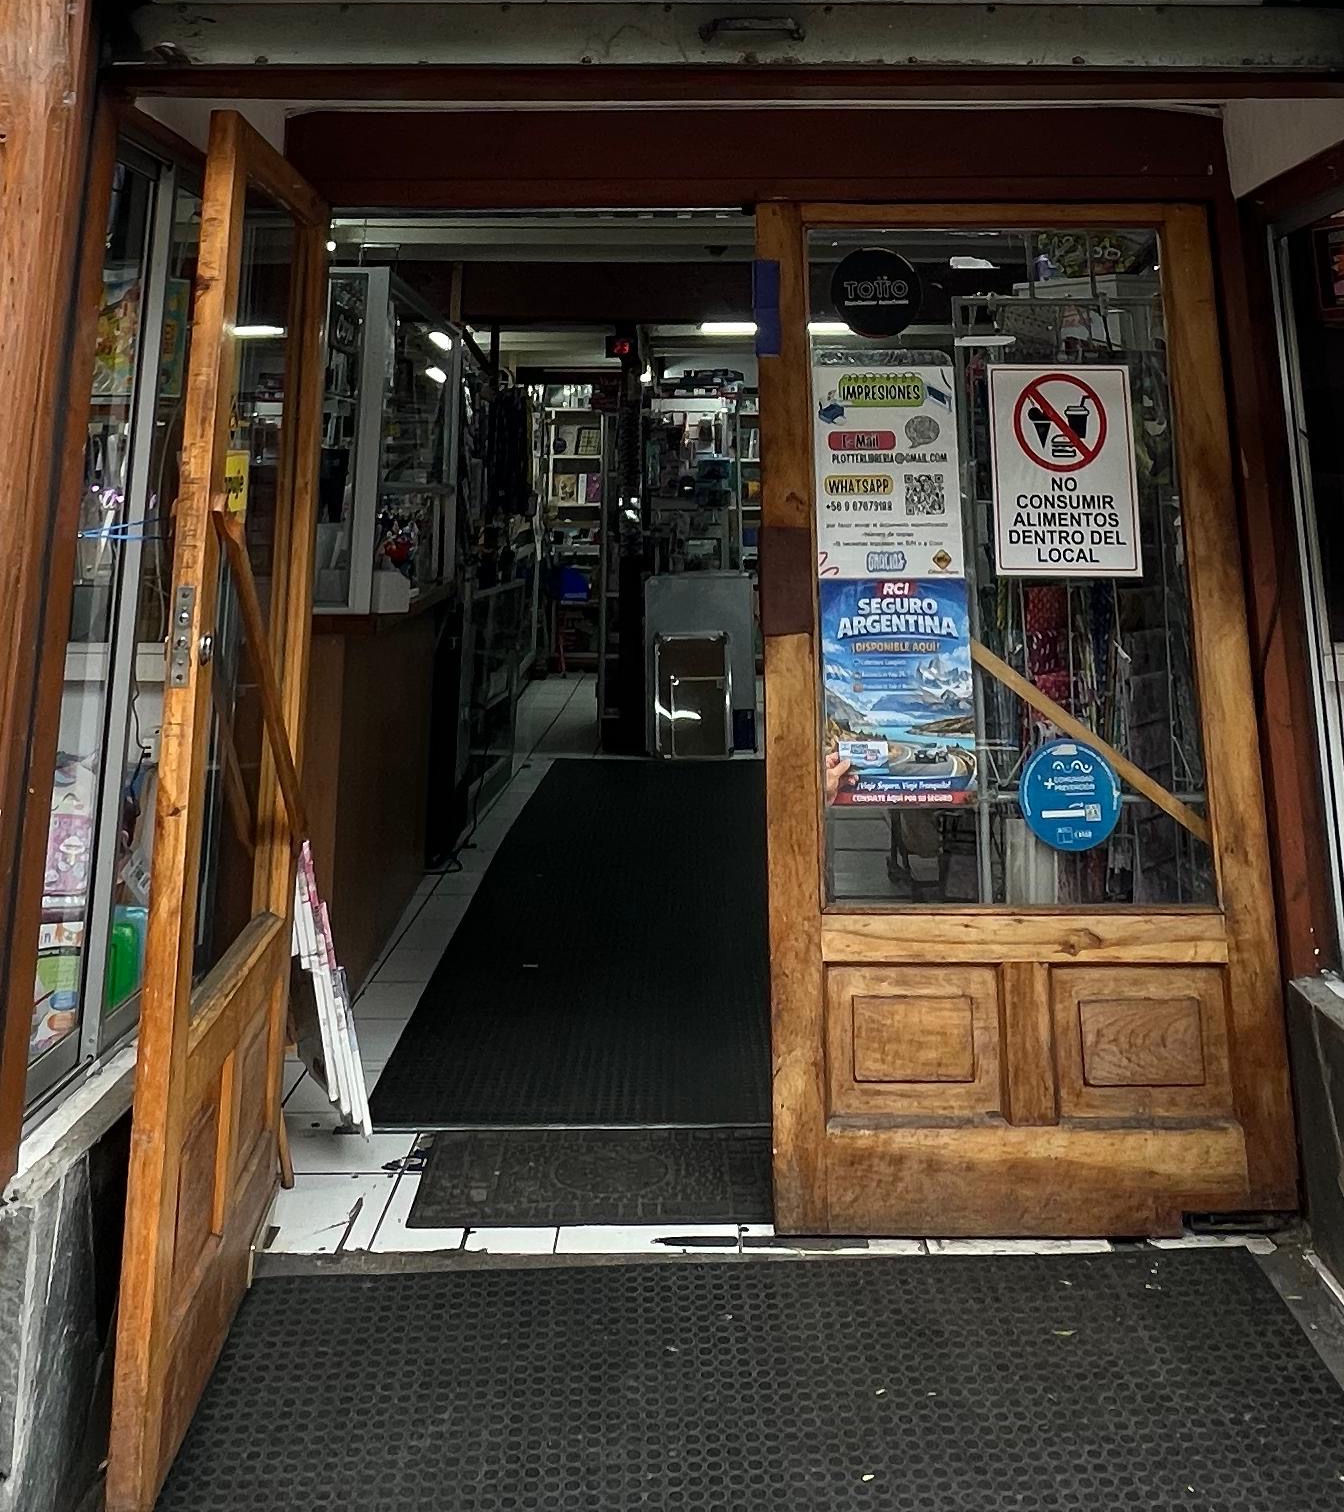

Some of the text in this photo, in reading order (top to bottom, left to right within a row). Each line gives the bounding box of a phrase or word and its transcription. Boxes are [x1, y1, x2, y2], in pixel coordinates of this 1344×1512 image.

[842, 385, 921, 400] IMPRESIONES
[828, 478, 889, 494] WHATSAPP
[1051, 477, 1077, 492] NO
[1016, 494, 1115, 509] CONSUMIR
[1013, 512, 1119, 527] ALIMENTOS
[1009, 529, 1127, 545] DENTRO DEL
[1037, 548, 1100, 563] LOCAL
[882, 583, 910, 595] RCI
[858, 598, 938, 615] SEGURO
[837, 615, 959, 640] ARGENTINA
